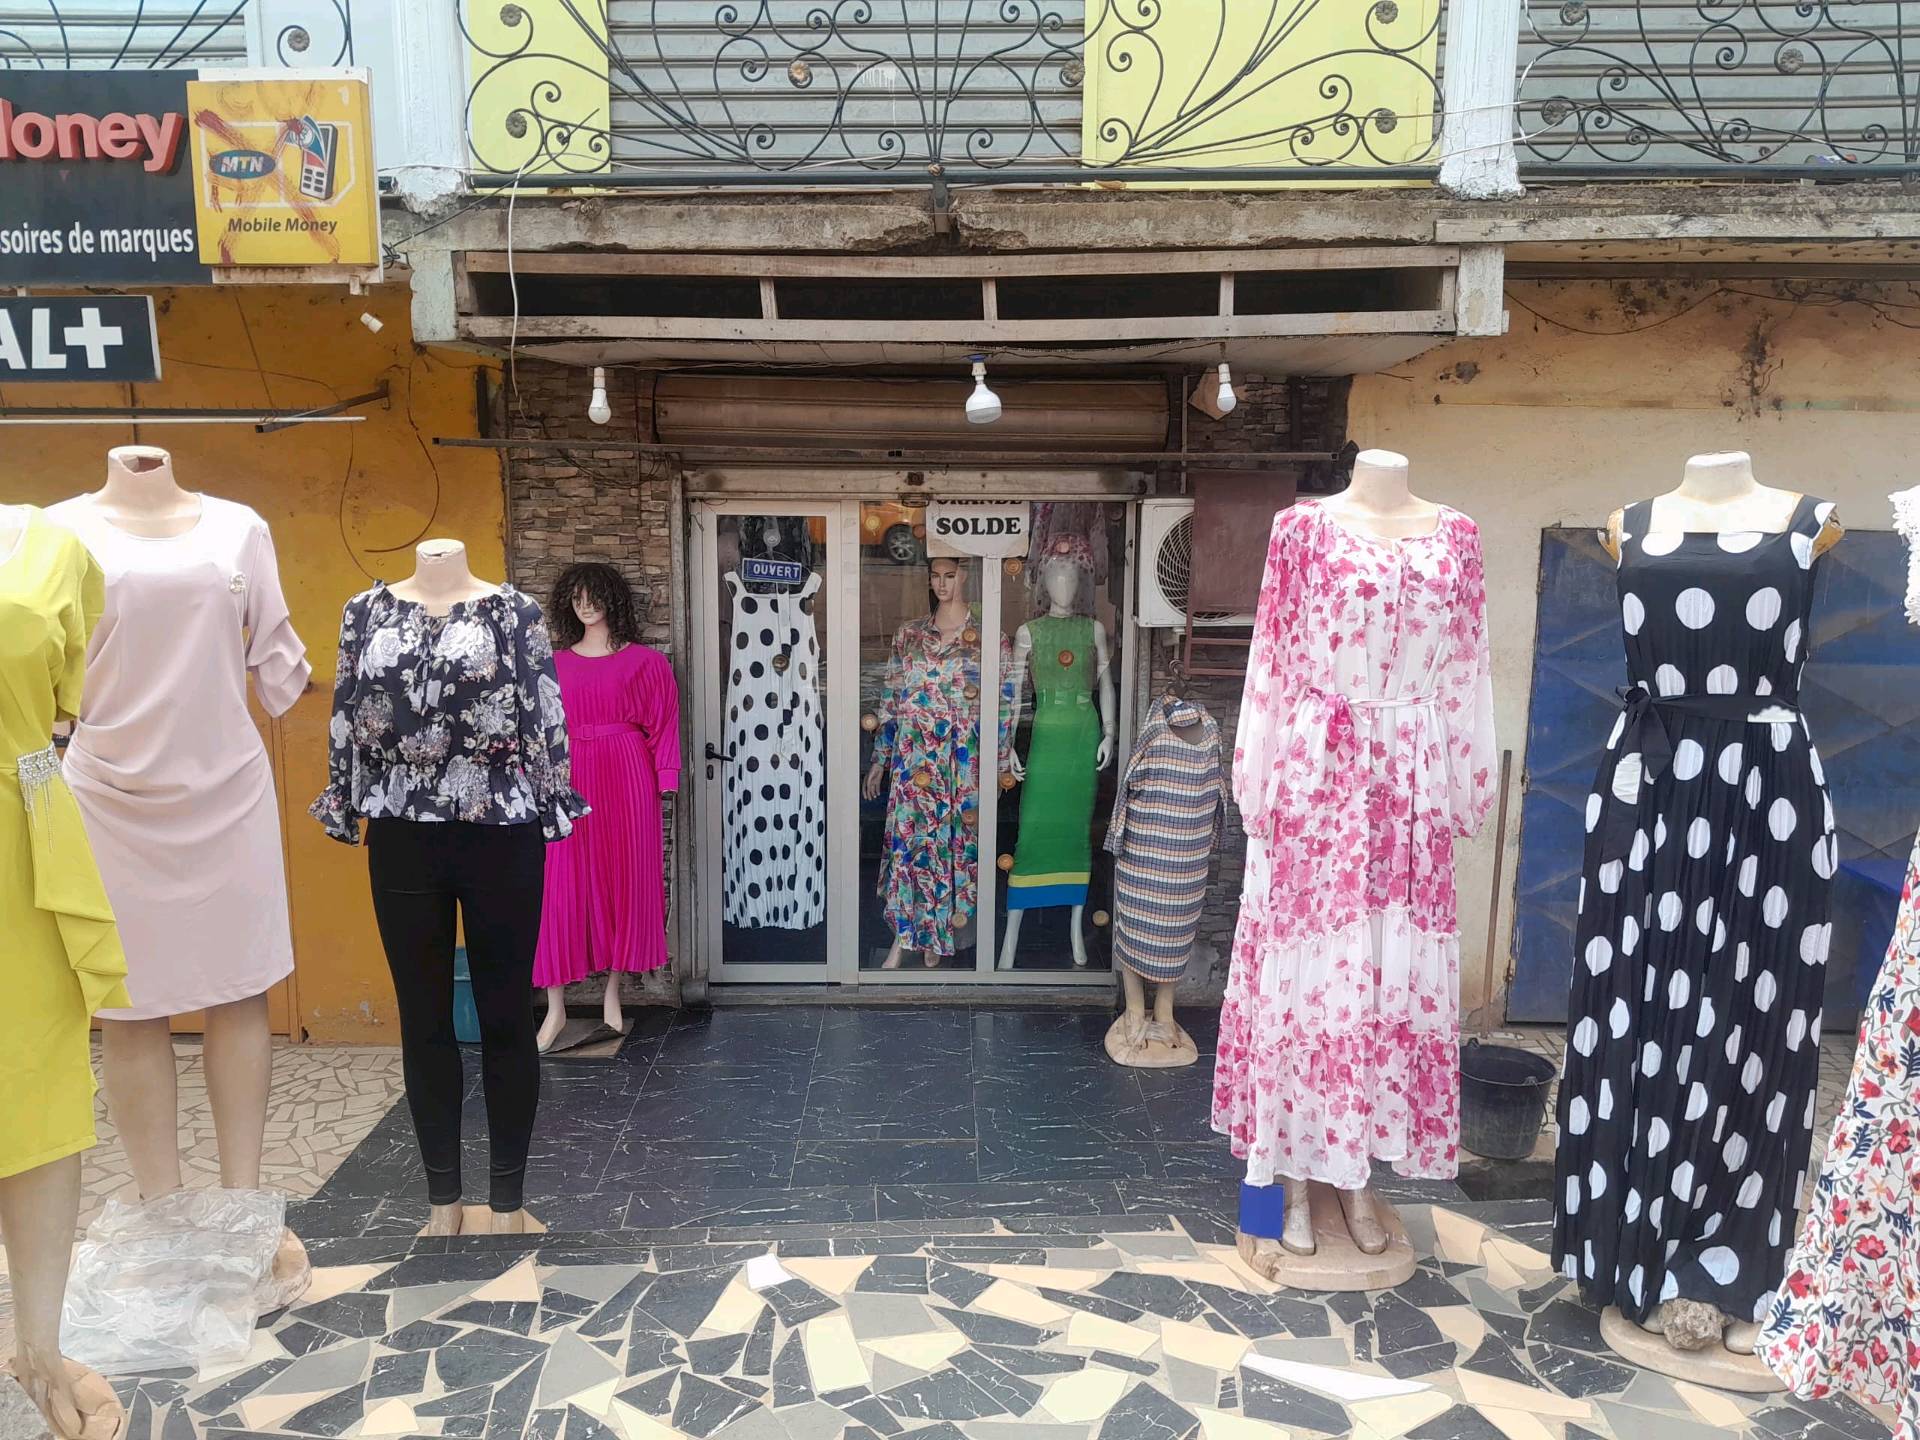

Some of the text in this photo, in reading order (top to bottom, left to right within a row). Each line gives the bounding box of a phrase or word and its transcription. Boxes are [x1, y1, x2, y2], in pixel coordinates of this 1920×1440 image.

[0, 97, 184, 172] oney
[221, 156, 264, 173] MTN
[228, 218, 338, 235] Mobile Money
[68, 221, 95, 254] de
[100, 227, 194, 262] marques
[936, 517, 1021, 535] SOLDE
[753, 563, 800, 578] OUVERT
